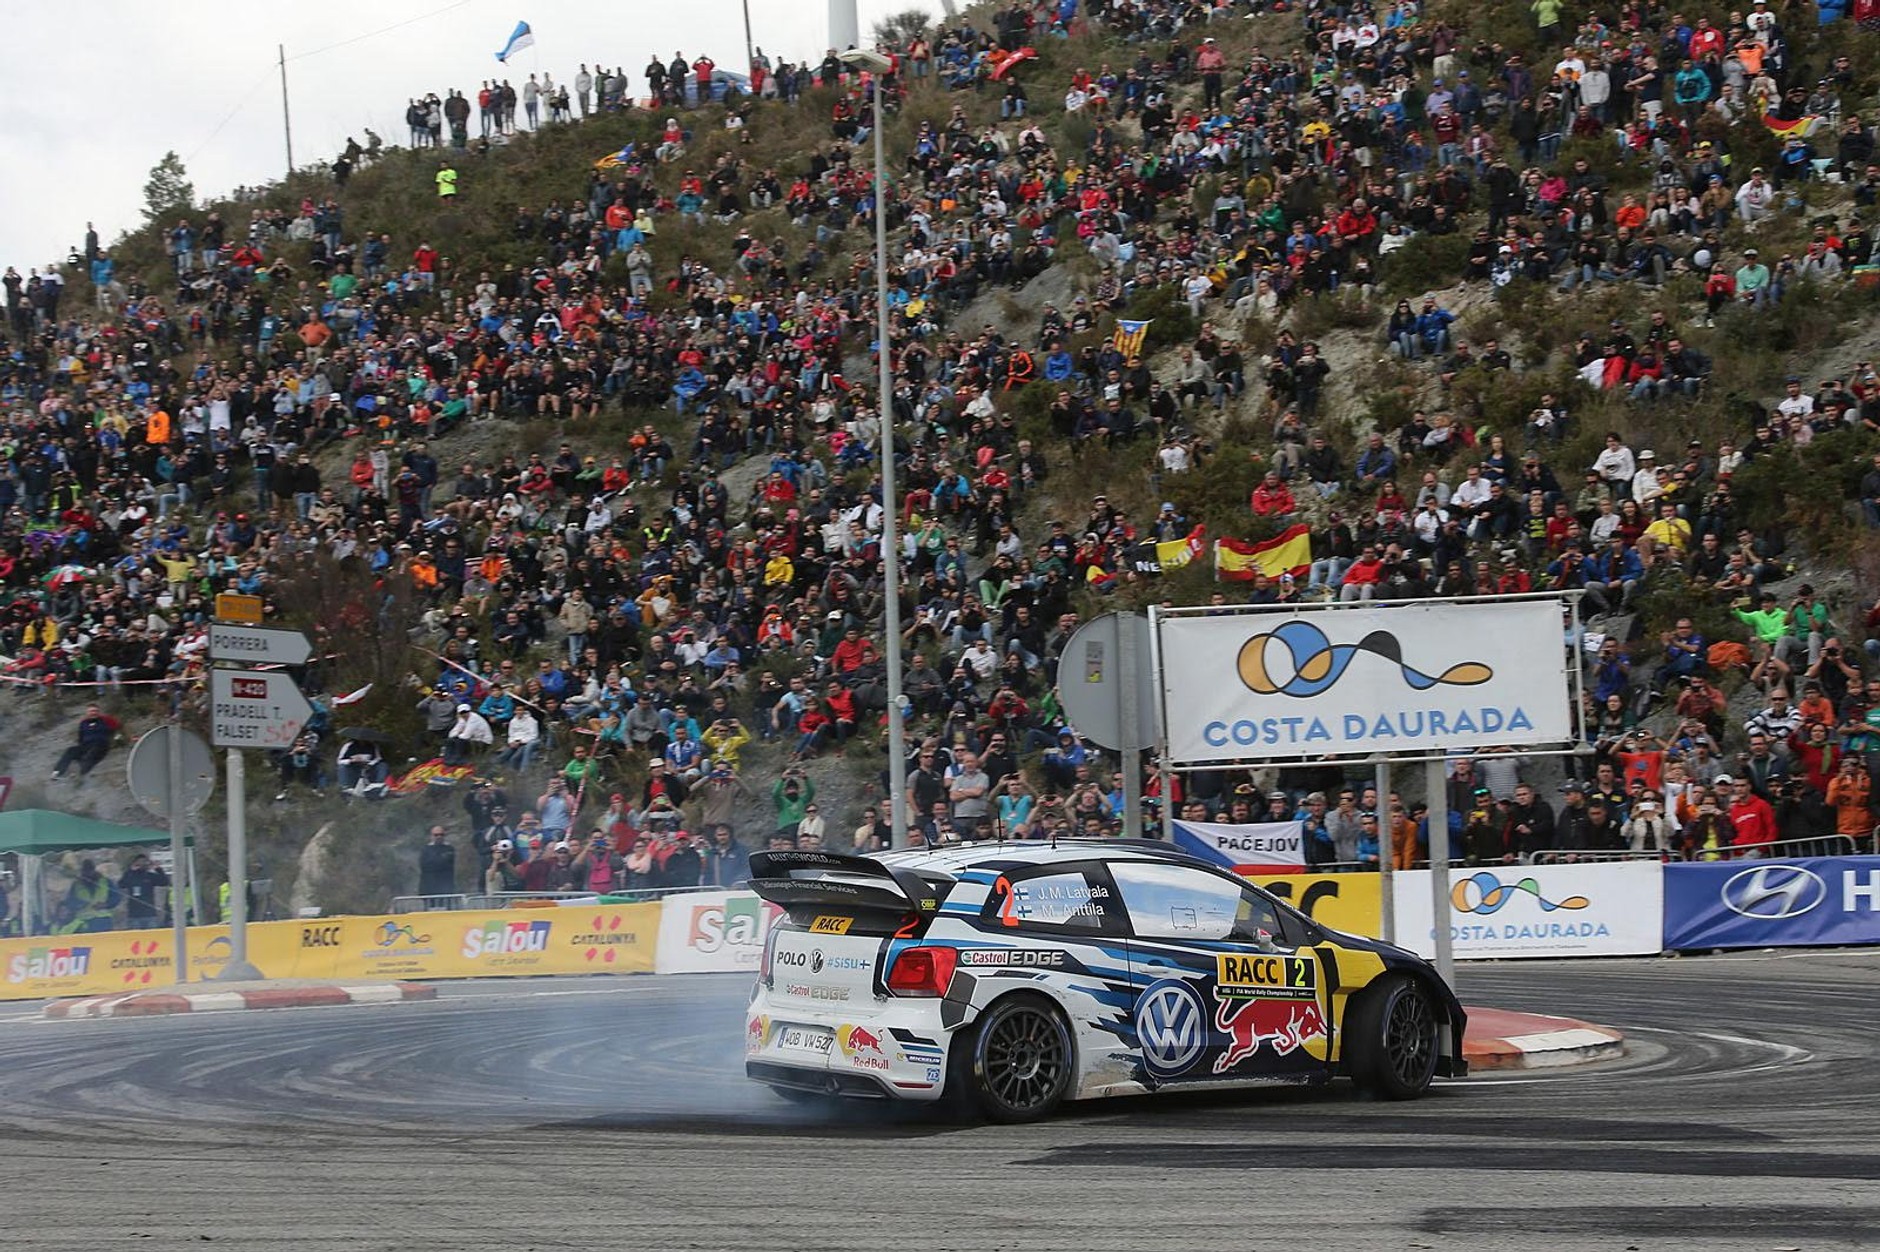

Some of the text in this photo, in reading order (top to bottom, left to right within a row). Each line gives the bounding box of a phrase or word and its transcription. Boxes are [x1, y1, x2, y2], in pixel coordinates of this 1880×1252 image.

[213, 635, 269, 651] PORRERA
[216, 703, 283, 720] PRADELL T.
[216, 724, 259, 739] FALSET
[1203, 707, 1534, 747] COSTA DAURADA
[1218, 836, 1300, 852] PAČEJOV
[823, 883, 858, 894] Services
[1066, 885, 1109, 899] Latvala
[996, 876, 1019, 926] 2
[1064, 902, 1105, 917] Anttila
[816, 917, 845, 931] RACC
[1504, 922, 1611, 939] DAURADA
[302, 926, 340, 947] RACC
[463, 926, 547, 959] Salou
[571, 933, 637, 945] CATALUNYA
[110, 956, 171, 968] CATALUNYA
[777, 952, 806, 966] POLO
[972, 951, 1065, 966] Castrol EDGE
[9, 951, 86, 983] Salou
[1225, 957, 1306, 987] RACC 2
[790, 985, 850, 1001] Castrol EDGE
